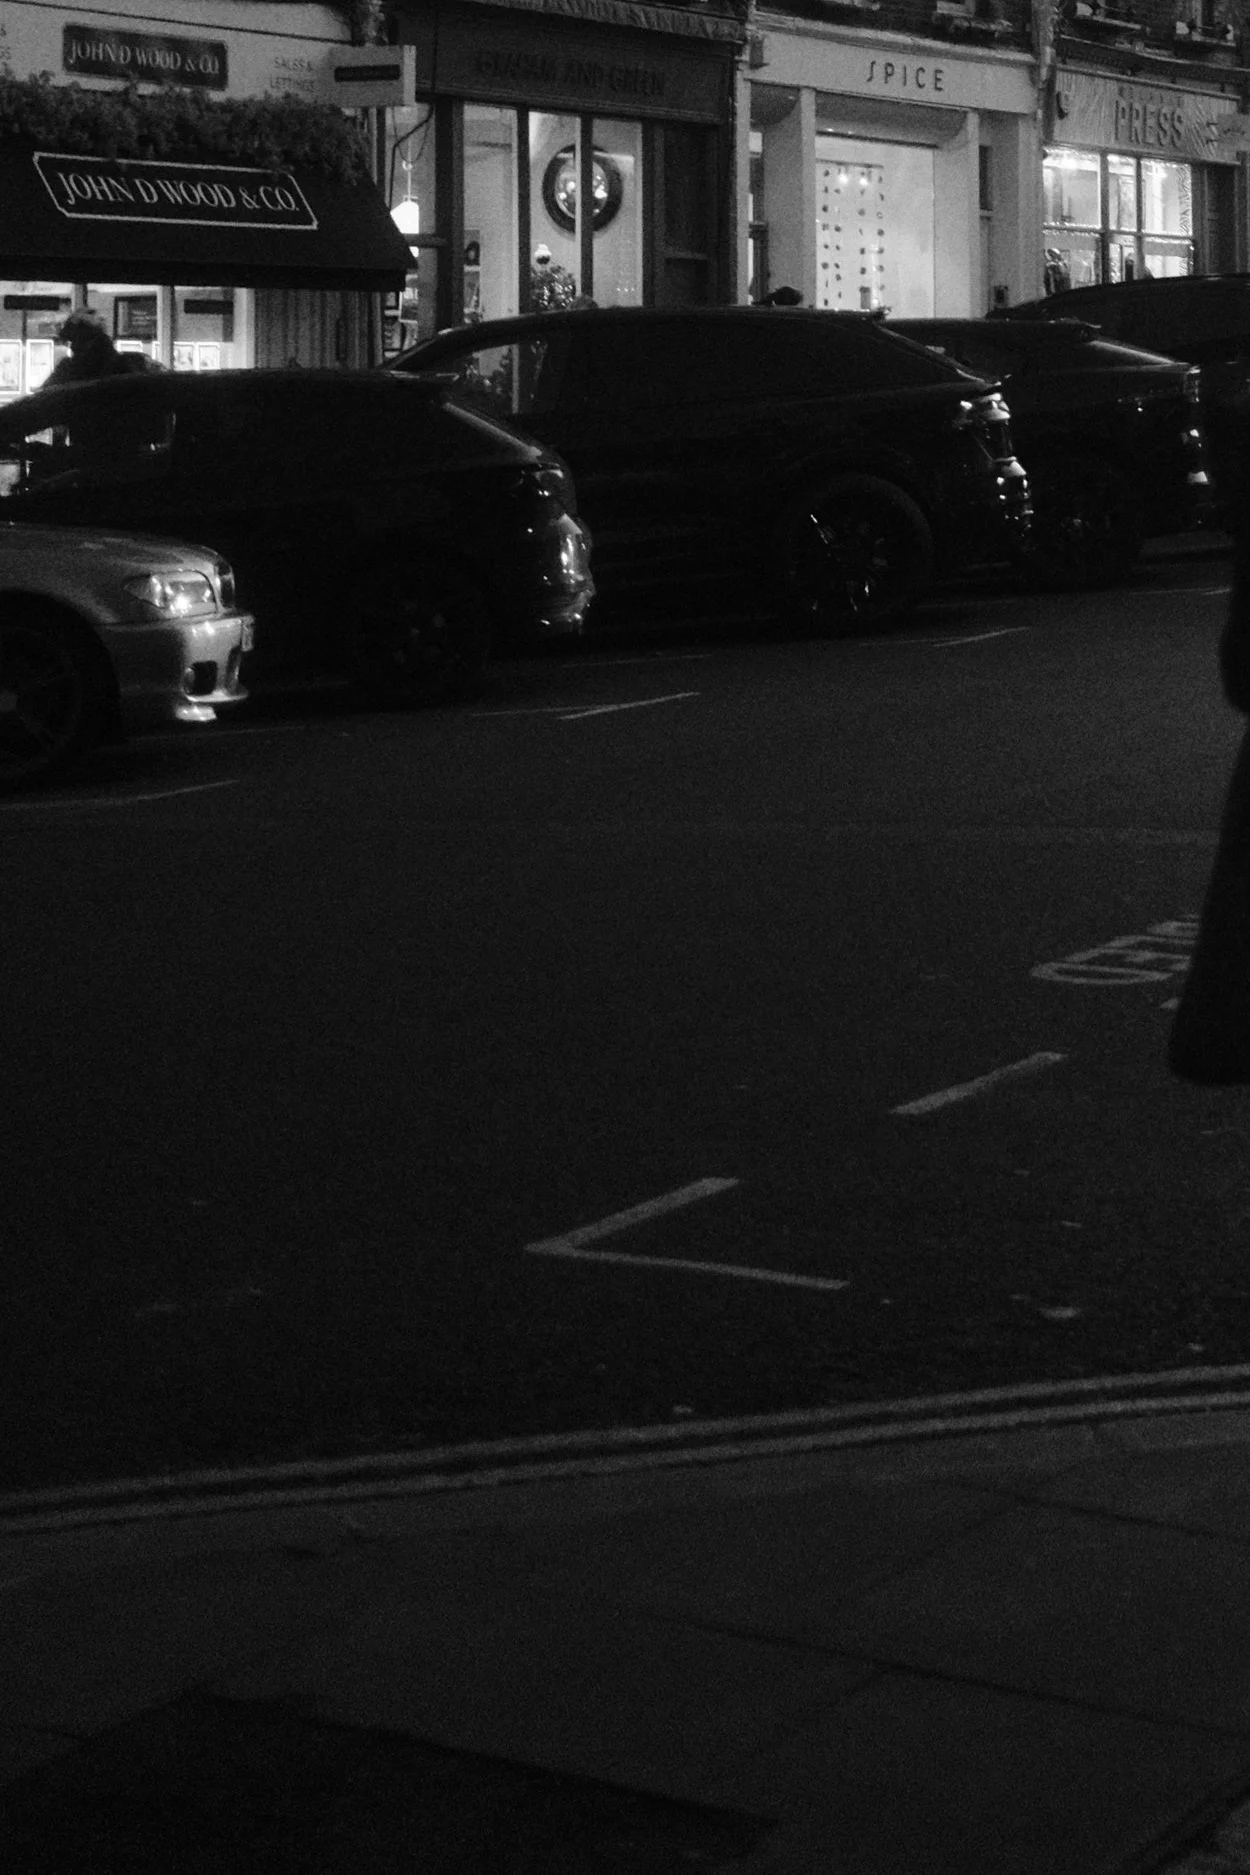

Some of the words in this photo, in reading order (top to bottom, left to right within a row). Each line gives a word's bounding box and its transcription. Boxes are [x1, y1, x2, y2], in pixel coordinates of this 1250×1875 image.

[68, 39, 119, 65] JOHN
[120, 45, 132, 65] D
[136, 47, 182, 71] WOOD
[866, 60, 945, 92] SPICE
[1114, 99, 1186, 150] PRESS
[58, 171, 136, 205] JOHN
[134, 178, 159, 205] D
[155, 179, 237, 209] WOOD
[238, 186, 261, 210] &
[259, 186, 300, 212] CO.
